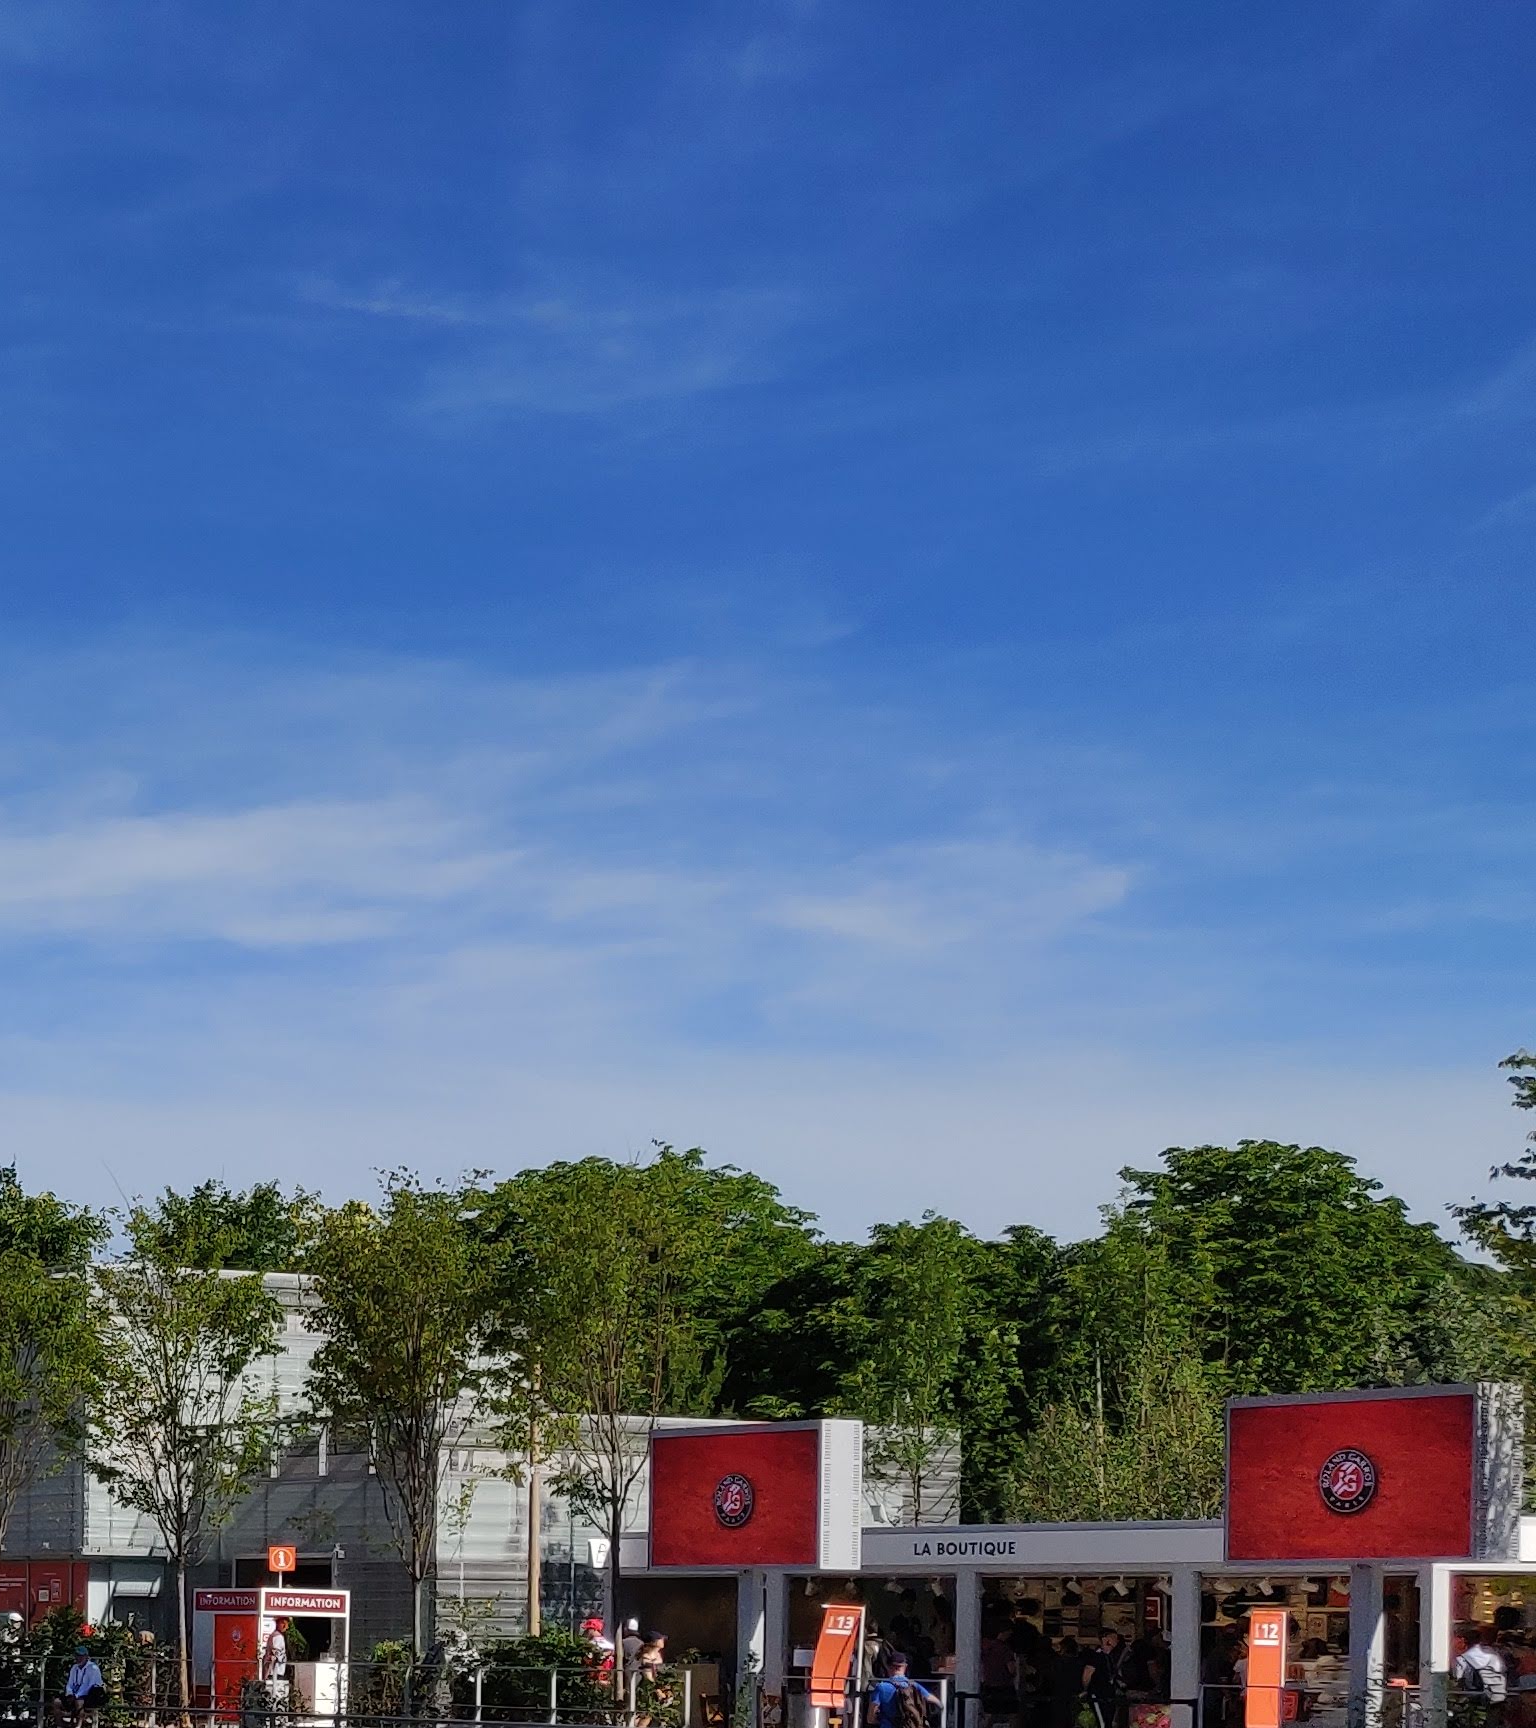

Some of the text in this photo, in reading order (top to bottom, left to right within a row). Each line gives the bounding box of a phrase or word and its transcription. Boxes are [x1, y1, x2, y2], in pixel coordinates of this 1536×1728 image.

[913, 1541, 1016, 1556] LA BOUTIQUE
[199, 1595, 256, 1607] INFORMATION
[270, 1596, 341, 1609] INFORMATION
[837, 1615, 855, 1630] 13
[1261, 1623, 1279, 1639] 12
